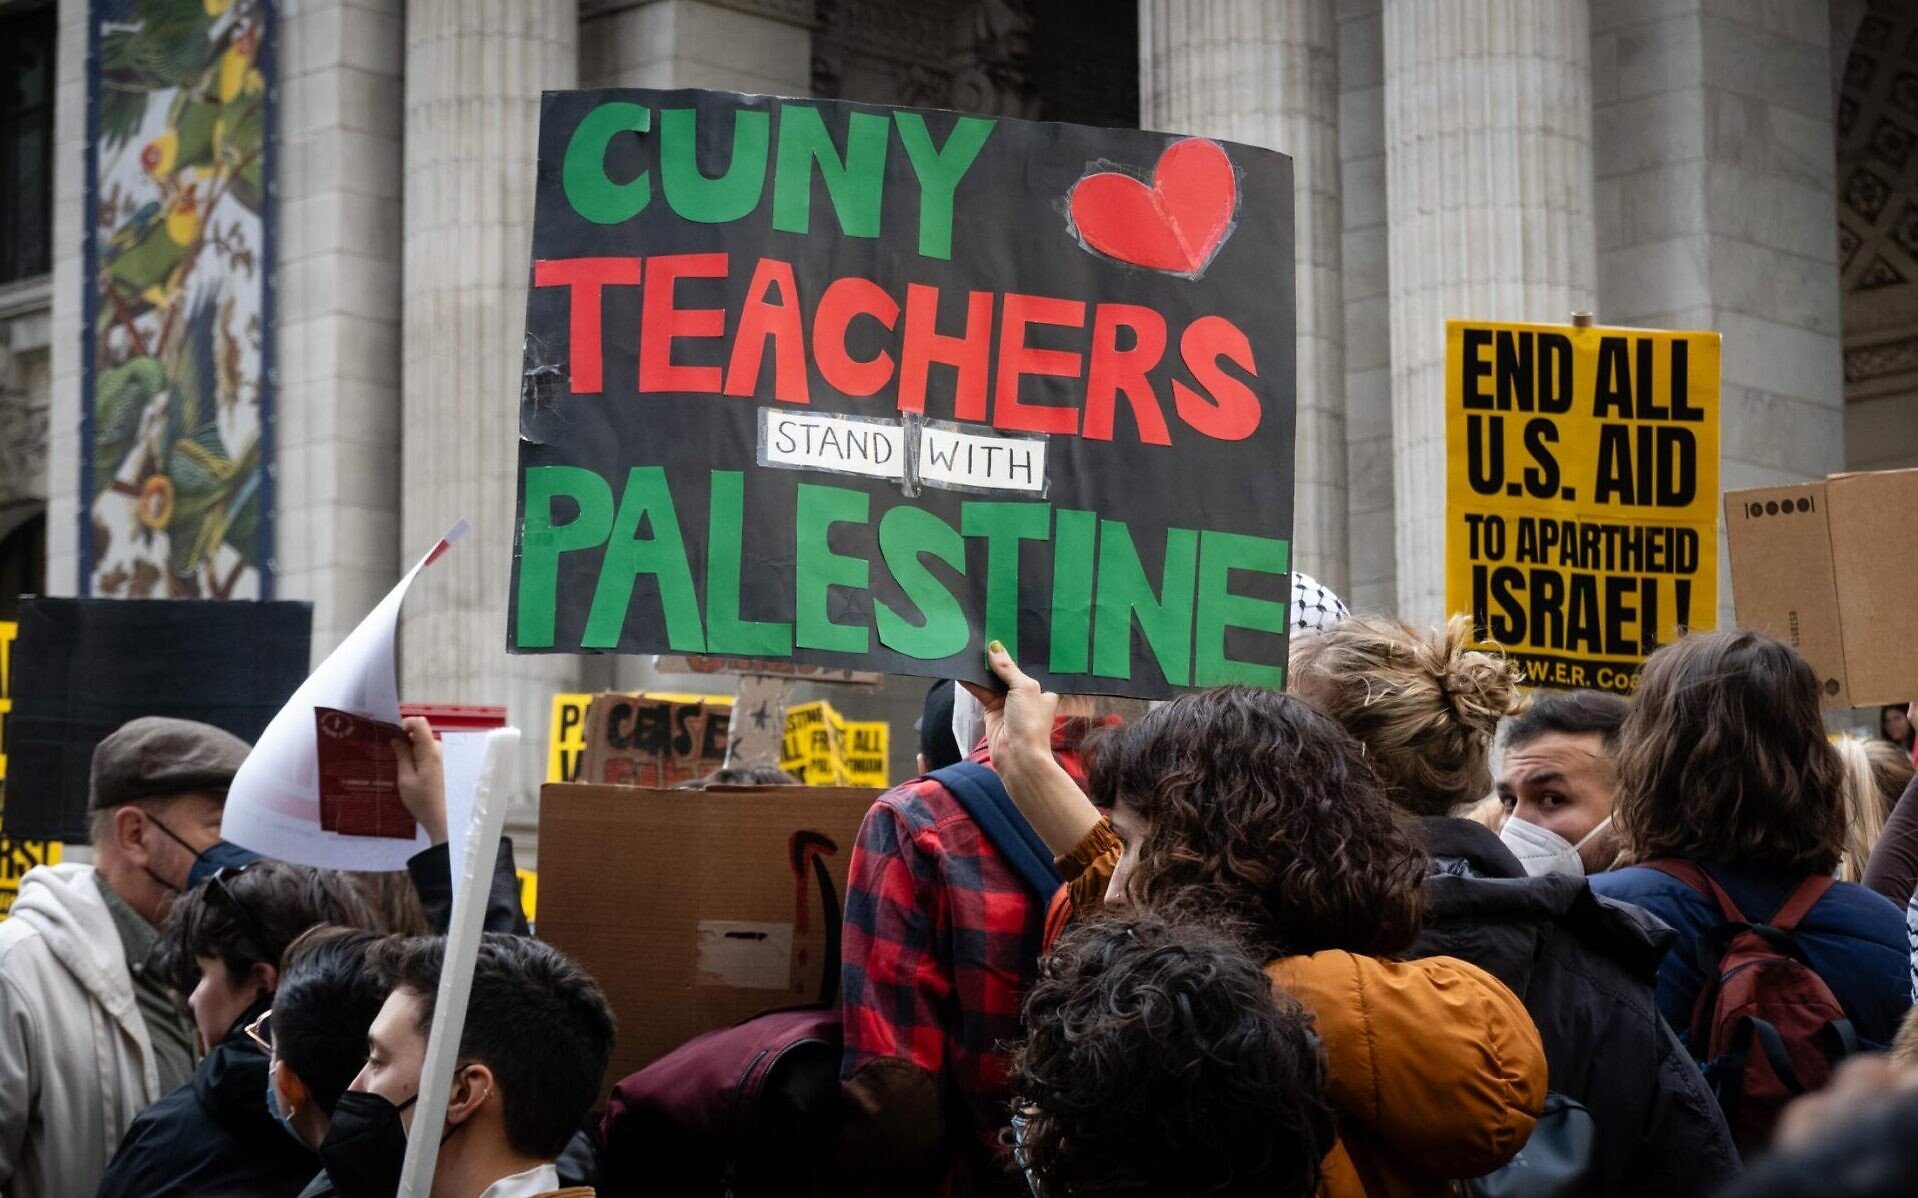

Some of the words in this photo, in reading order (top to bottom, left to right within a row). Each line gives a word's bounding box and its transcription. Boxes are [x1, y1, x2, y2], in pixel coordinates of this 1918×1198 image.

[563, 102, 994, 260] CUNY
[535, 252, 1262, 446] TEACHERS
[1462, 328, 1574, 415] END
[1593, 336, 1705, 423] ALL
[776, 420, 892, 465] STAND
[929, 437, 1033, 484] WITH
[1467, 414, 1576, 502] U.S.
[1594, 424, 1697, 508] AID
[517, 465, 1288, 689] PALESTINE
[1464, 513, 1506, 562] TO
[1515, 517, 1699, 575] APARTHEID
